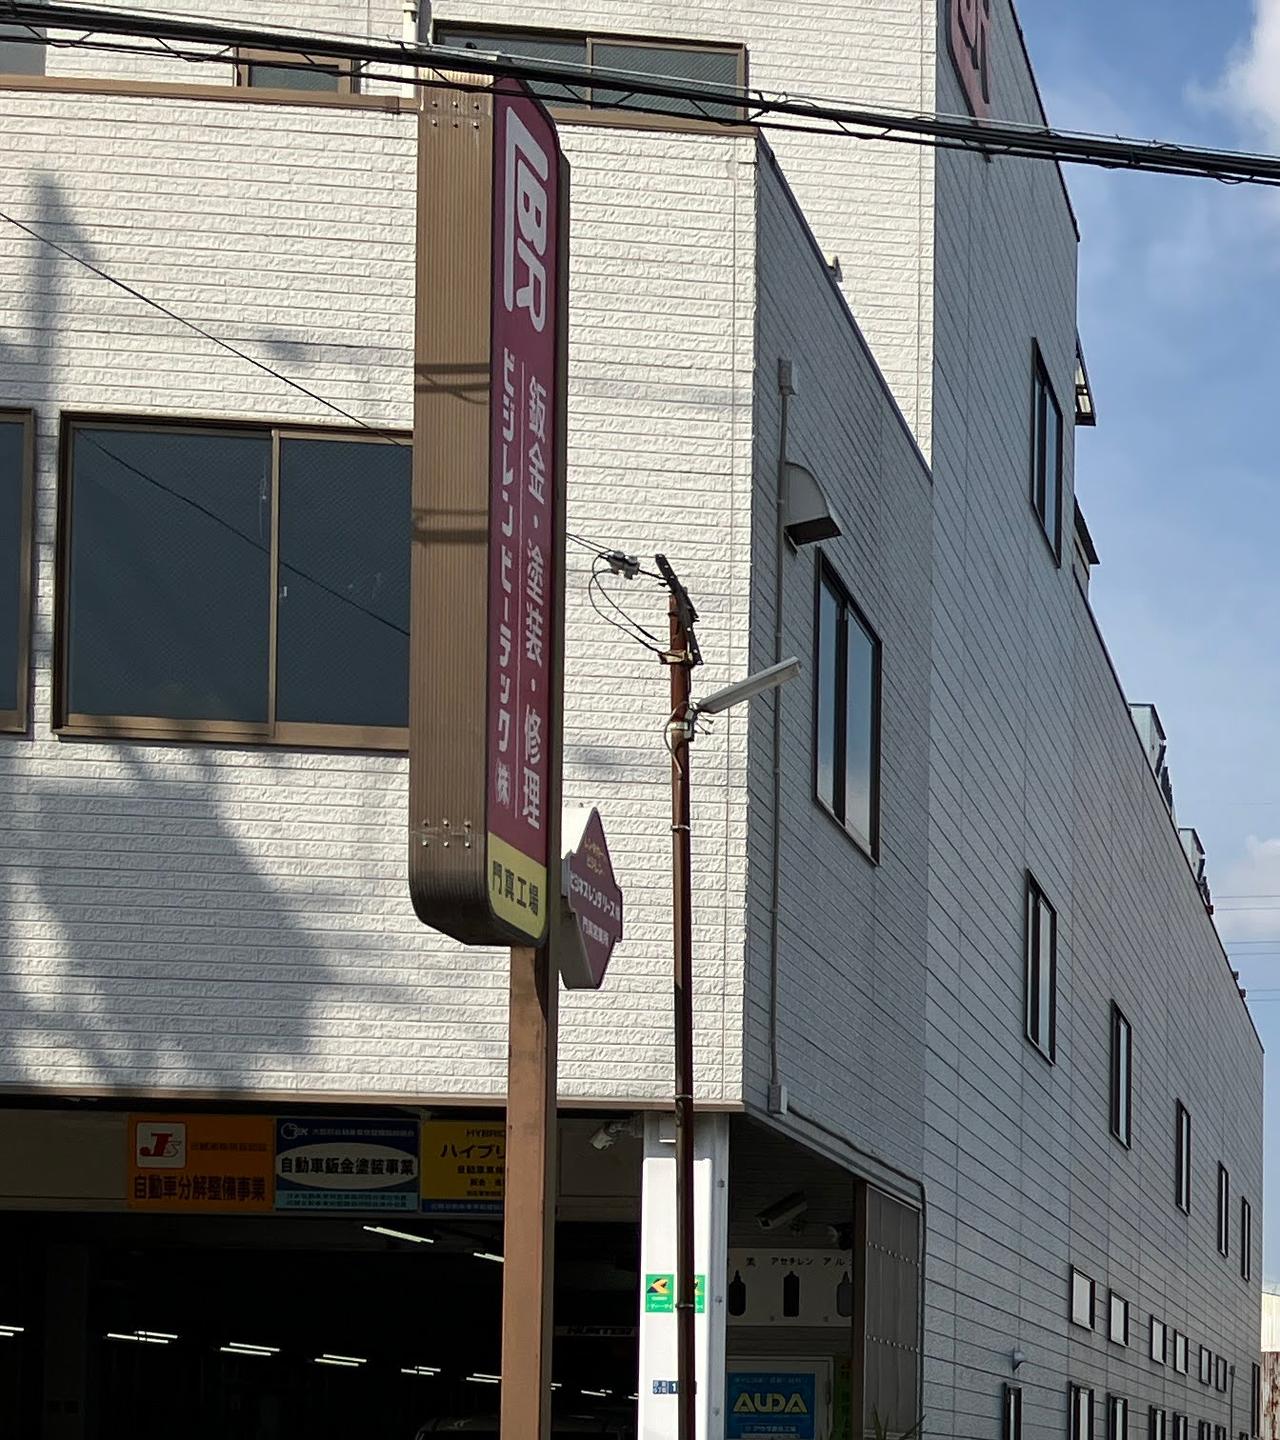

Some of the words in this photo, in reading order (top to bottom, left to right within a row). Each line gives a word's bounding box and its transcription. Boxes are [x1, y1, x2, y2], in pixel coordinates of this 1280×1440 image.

[503, 106, 549, 333] LBR
[492, 860, 539, 916] 門真工場
[771, 1256, 813, 1266] アセチレン
[733, 1393, 808, 1413] AUDA
